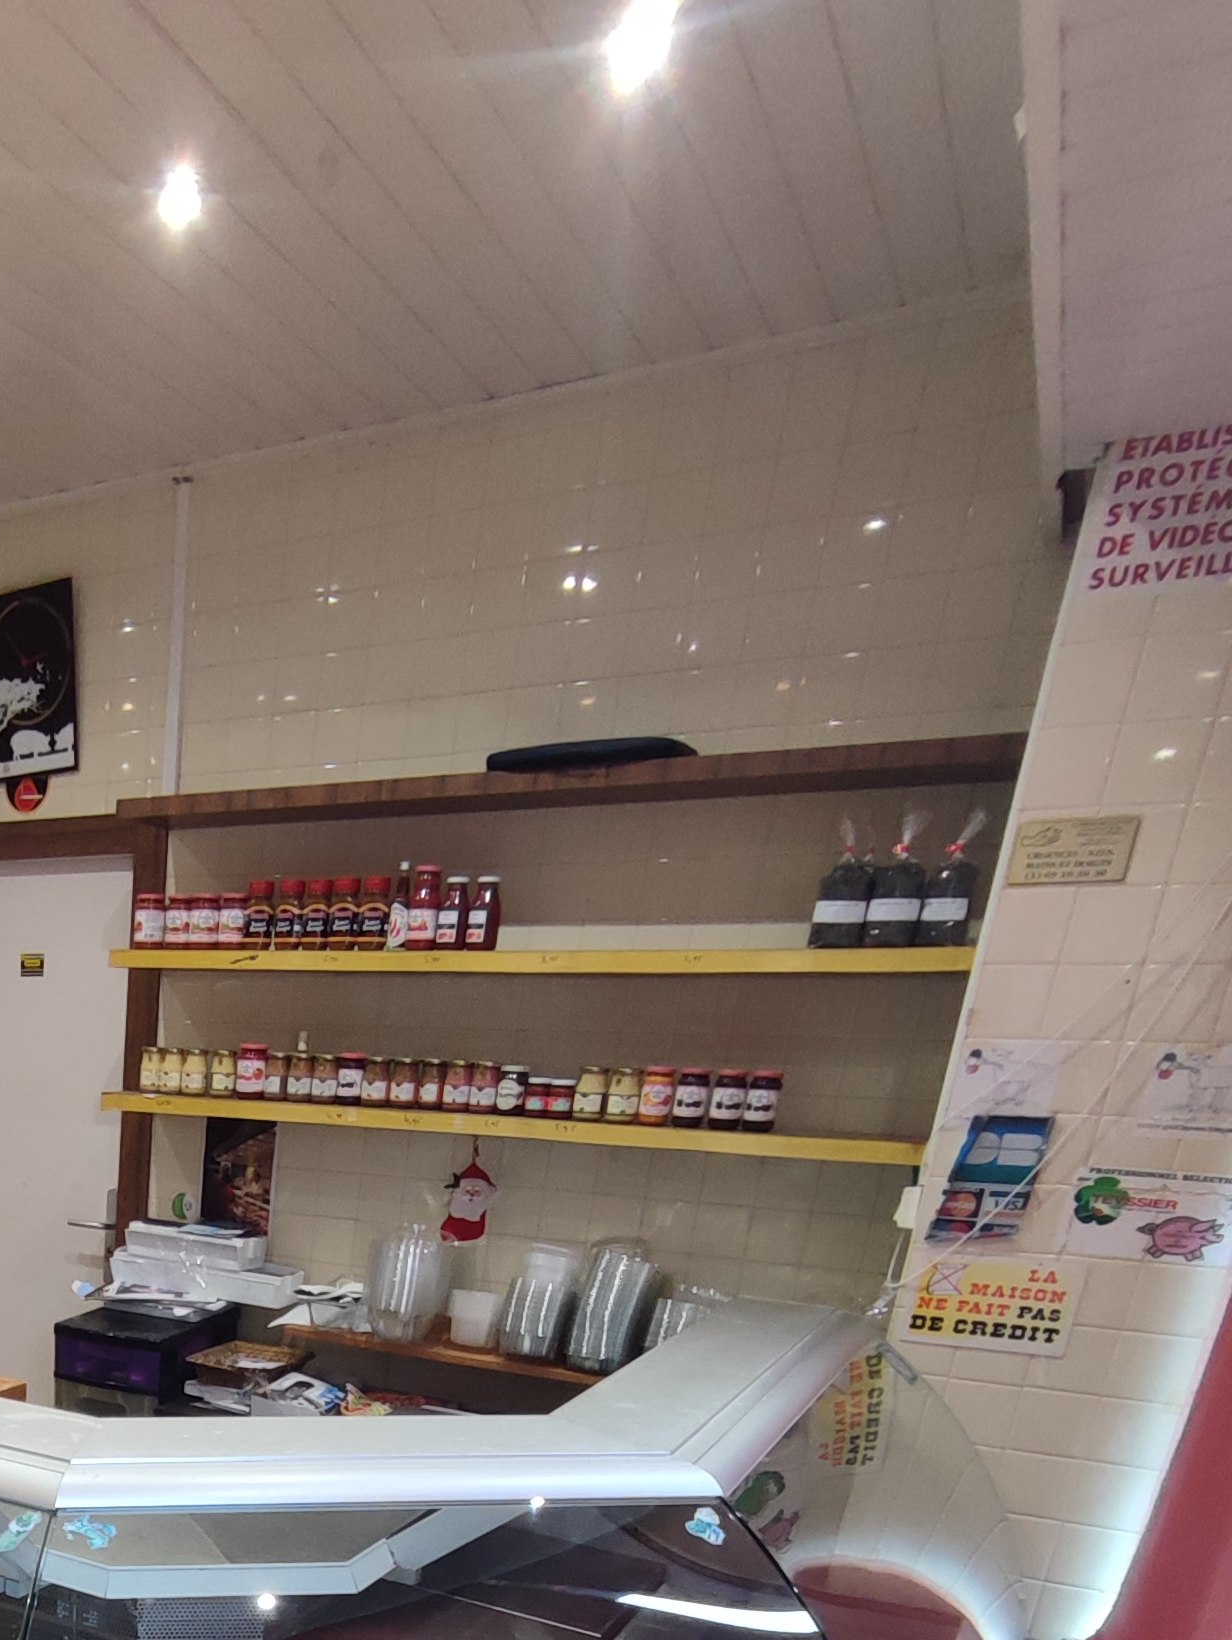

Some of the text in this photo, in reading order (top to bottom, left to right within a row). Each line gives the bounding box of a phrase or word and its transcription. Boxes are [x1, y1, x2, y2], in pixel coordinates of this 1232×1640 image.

[1096, 533, 1136, 559] DE
[1028, 1269, 1059, 1285] LA
[969, 1282, 1068, 1304] MAISON
[916, 1296, 1062, 1323] NE FAIT PAS
[909, 1314, 1061, 1344] DE CREDIT
